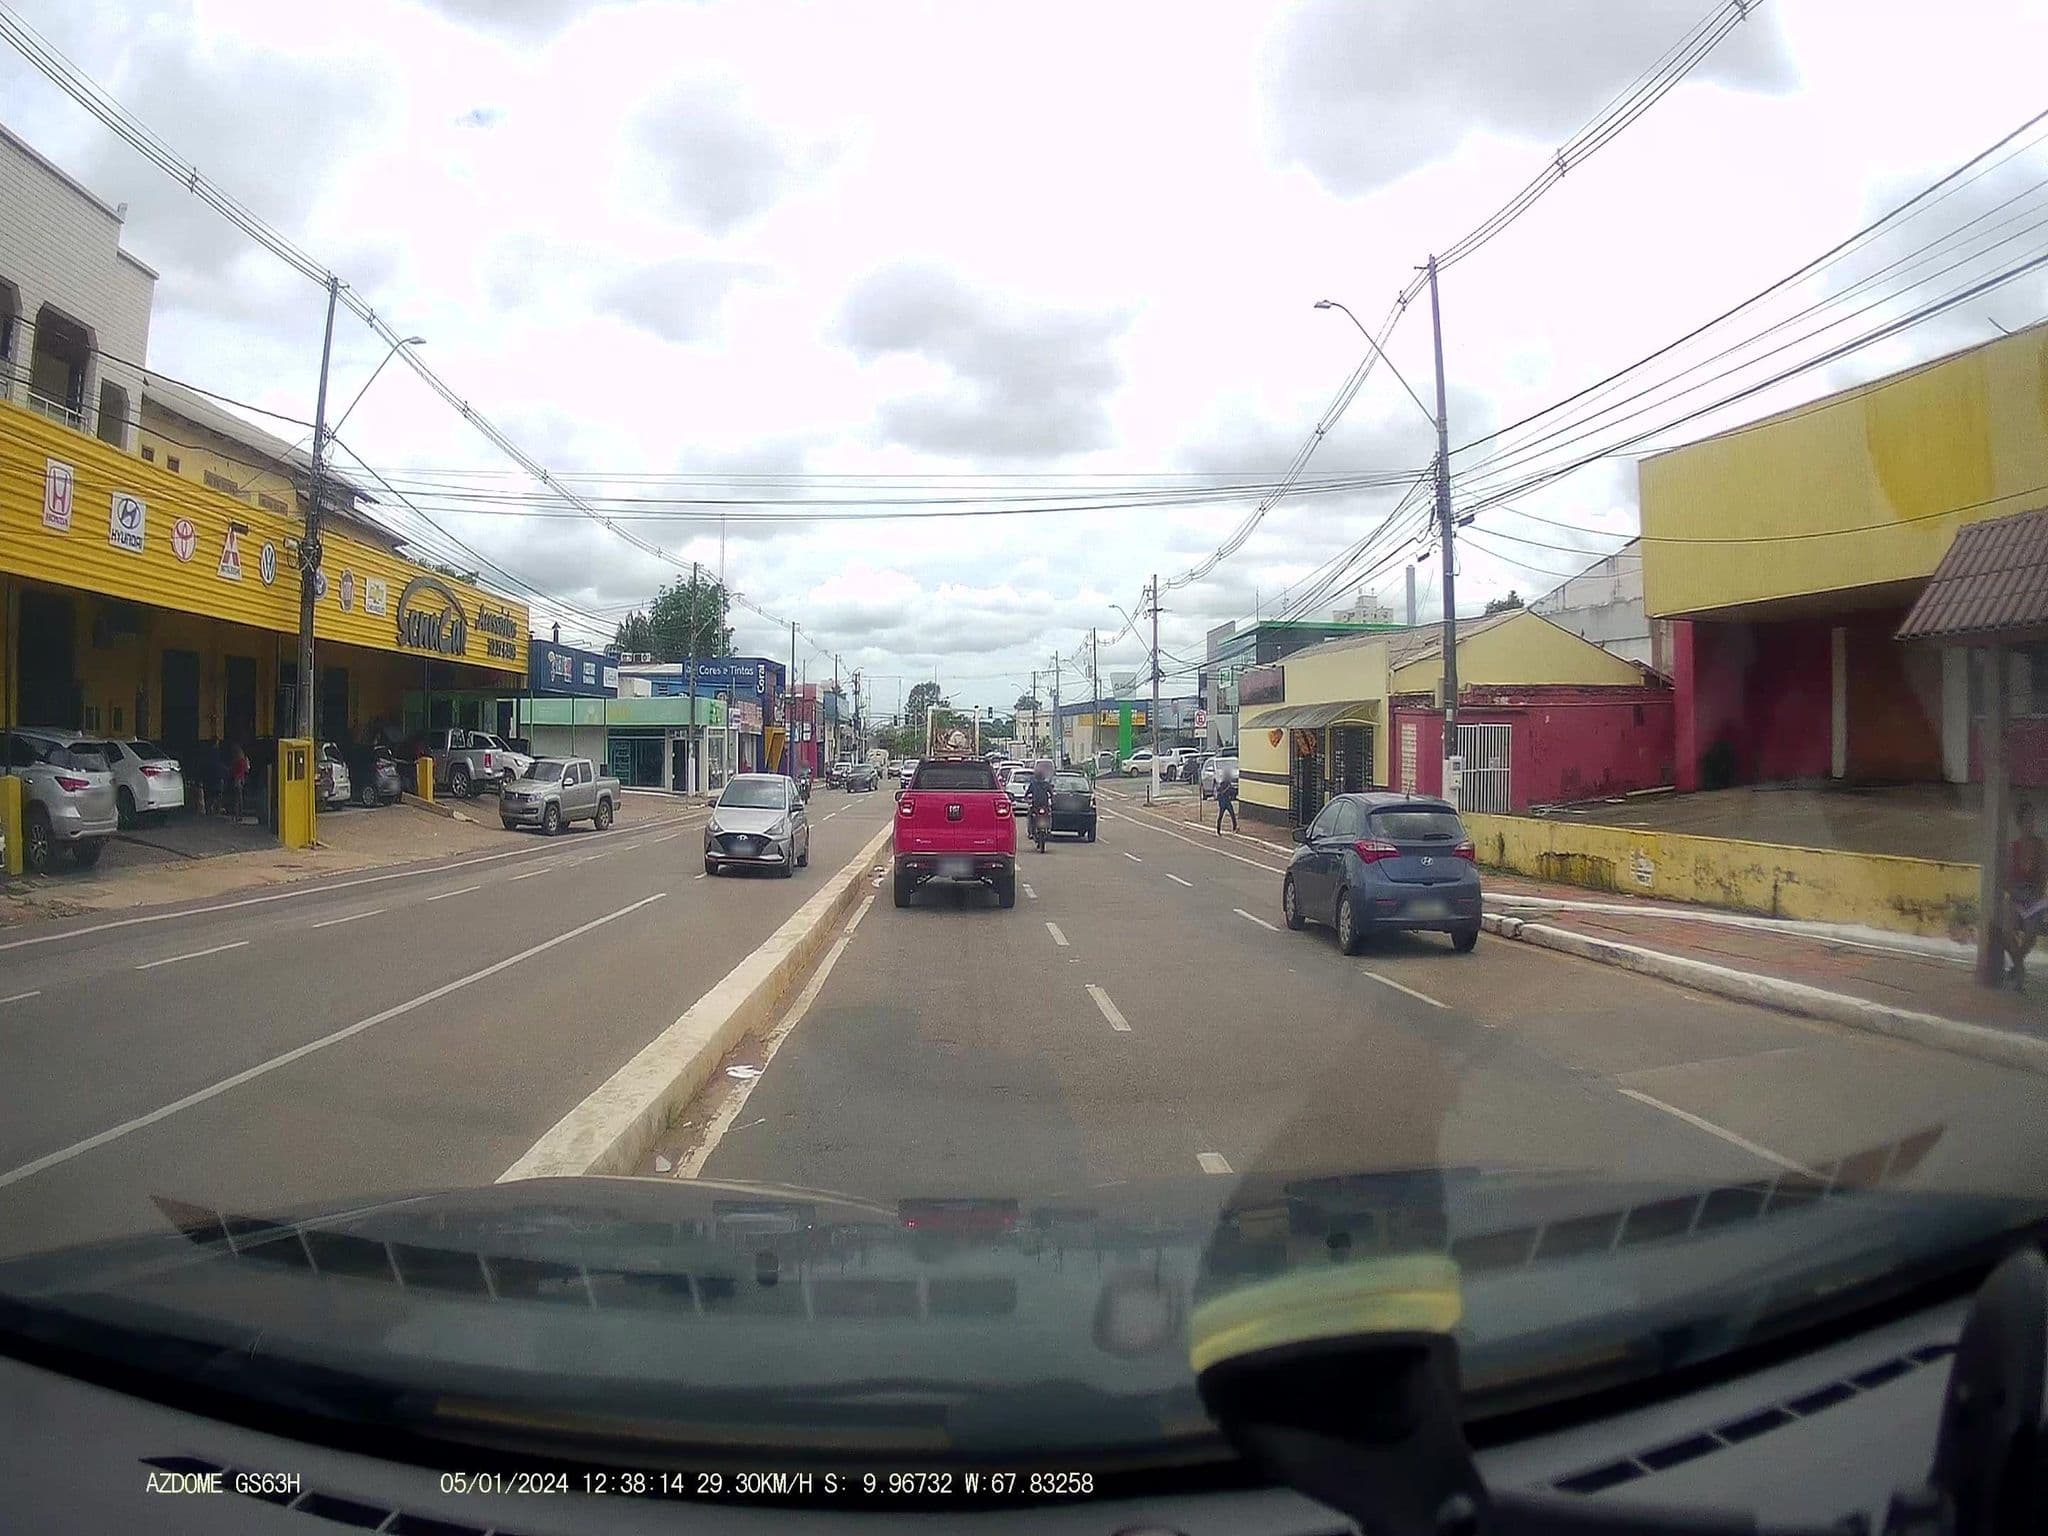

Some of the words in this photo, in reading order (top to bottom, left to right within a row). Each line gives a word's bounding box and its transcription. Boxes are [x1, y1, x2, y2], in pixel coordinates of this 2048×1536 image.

[111, 529, 143, 549] HYUNDAI
[699, 665, 721, 676] Cores
[730, 665, 754, 676] Tintas
[757, 664, 766, 694] Coral
